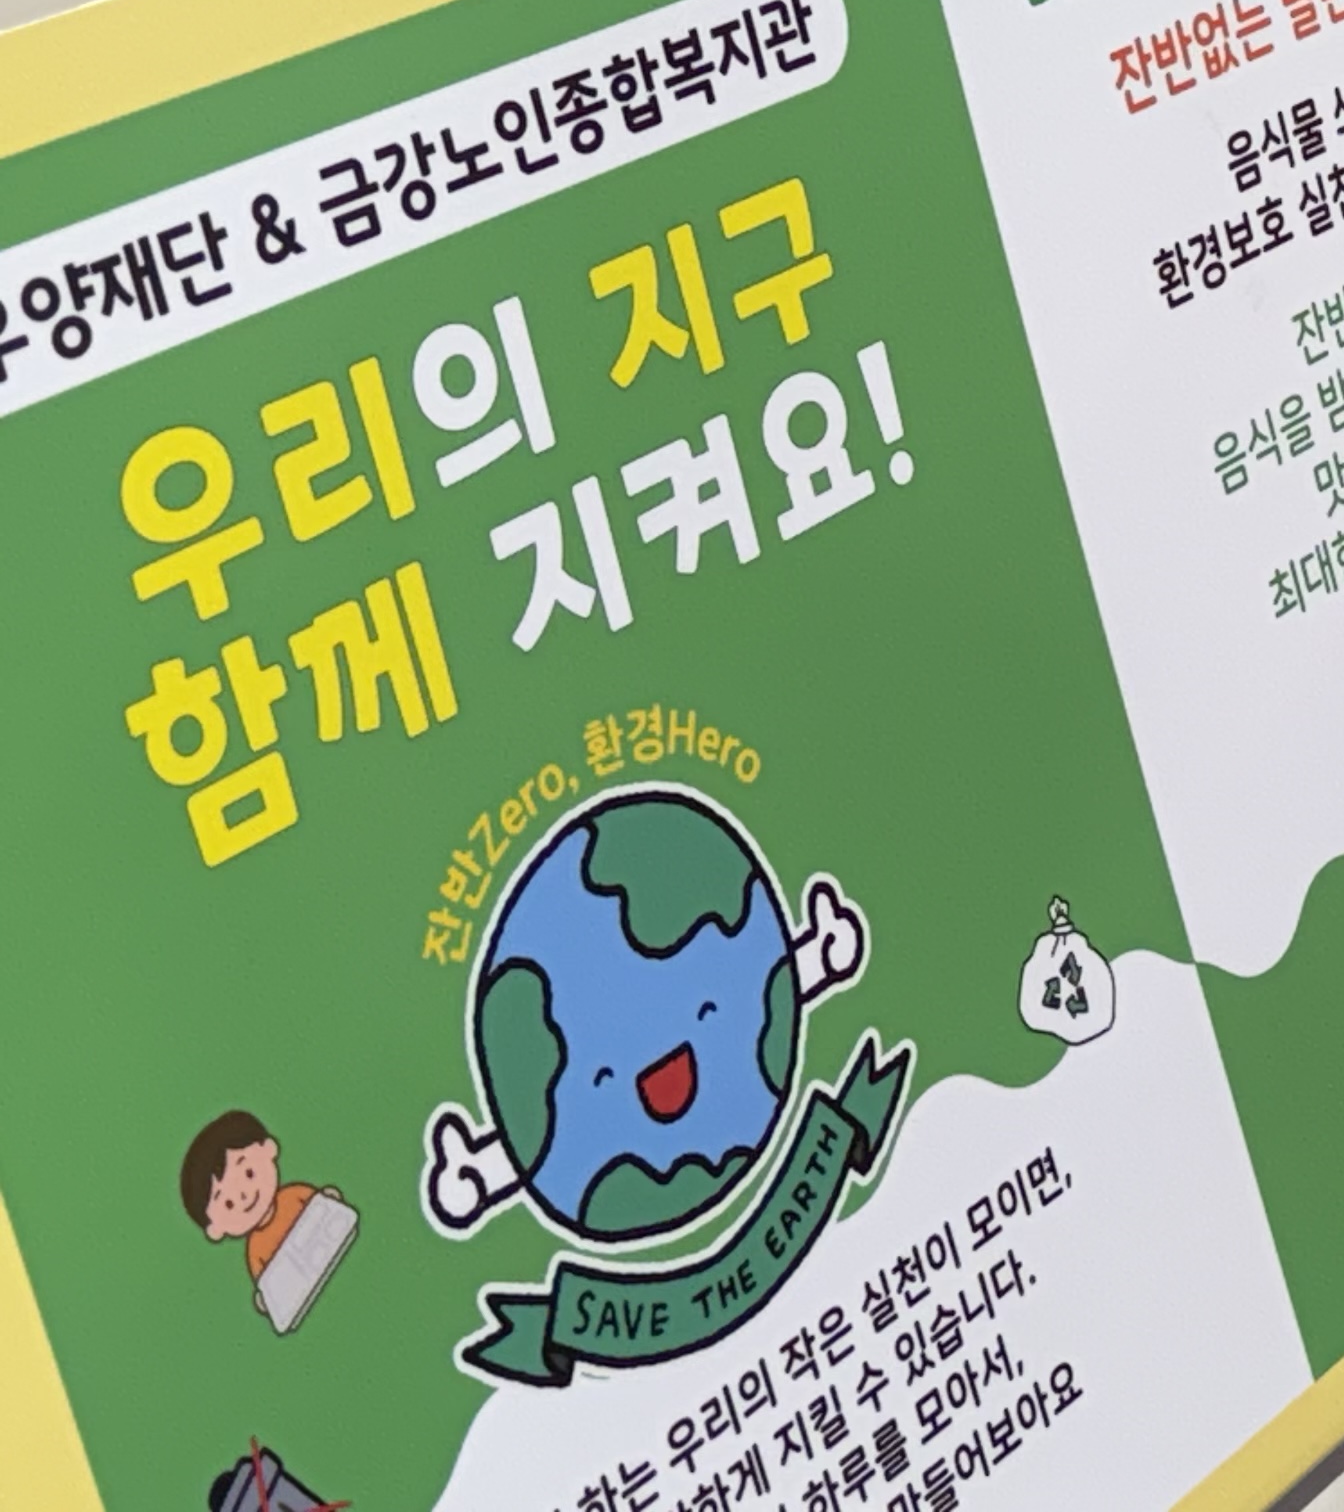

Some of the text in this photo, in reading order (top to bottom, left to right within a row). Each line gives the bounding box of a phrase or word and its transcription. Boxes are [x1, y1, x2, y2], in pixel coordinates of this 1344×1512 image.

[252, 193, 306, 264] &
[1152, 196, 1295, 310] 환경보호
[1226, 98, 1325, 191] 음식물
[120, 177, 834, 621] 우리의 지구
[1213, 393, 1313, 494] 음식을
[125, 337, 916, 868] 함께 지켜요!
[422, 703, 761, 966] 잔반Zero, 환경Hero
[571, 1123, 838, 1340] SAVE THE EARTH
[667, 1358, 778, 1473] 우리의
[780, 1305, 856, 1381] 작은
[861, 1220, 962, 1334] 실천이
[966, 1146, 1072, 1252] 모이면,
[676, 1249, 1037, 1512] 하게 지킬 수 있습니다.
[801, 1334, 1024, 1512] 하루를 모아서,
